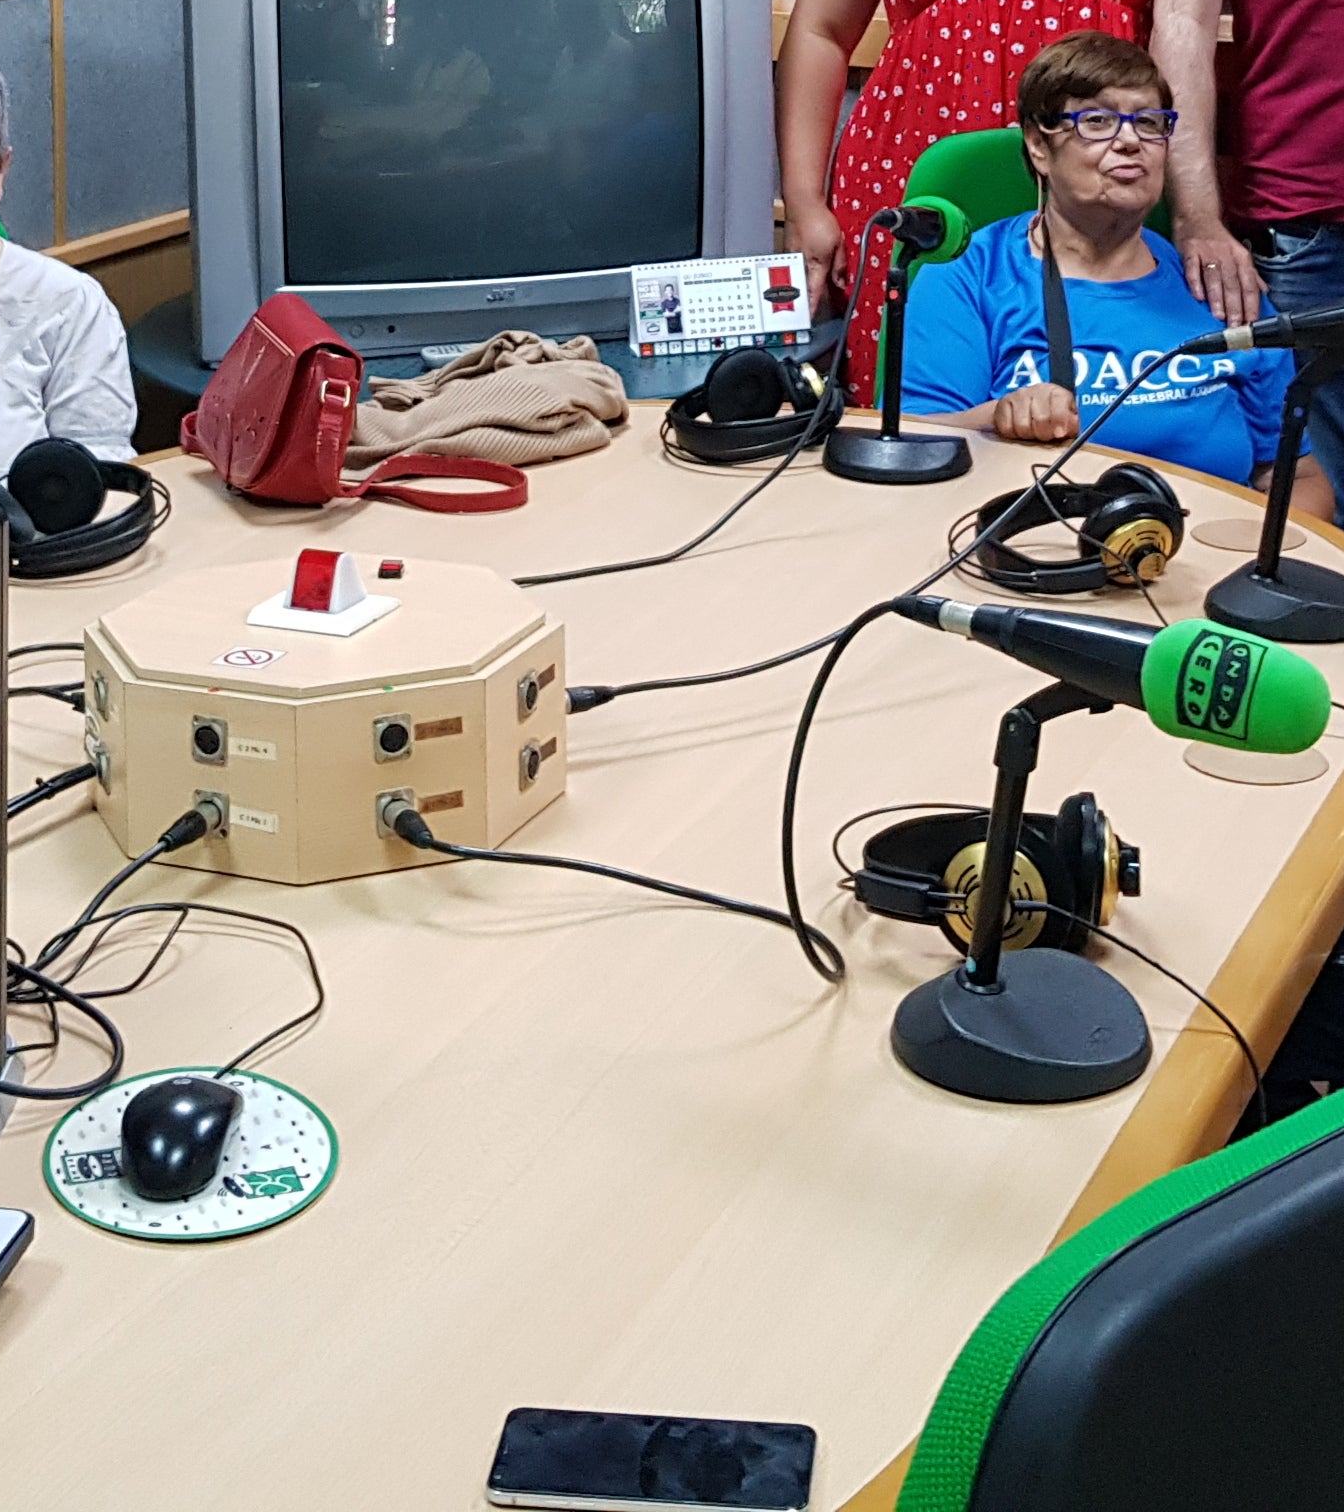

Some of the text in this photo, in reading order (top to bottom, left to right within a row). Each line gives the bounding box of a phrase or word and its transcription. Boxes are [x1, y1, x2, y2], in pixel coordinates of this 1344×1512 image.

[1123, 388, 1188, 405] CEREBRAL
[1187, 641, 1219, 716] CERO
[1217, 645, 1249, 722] ONDA
